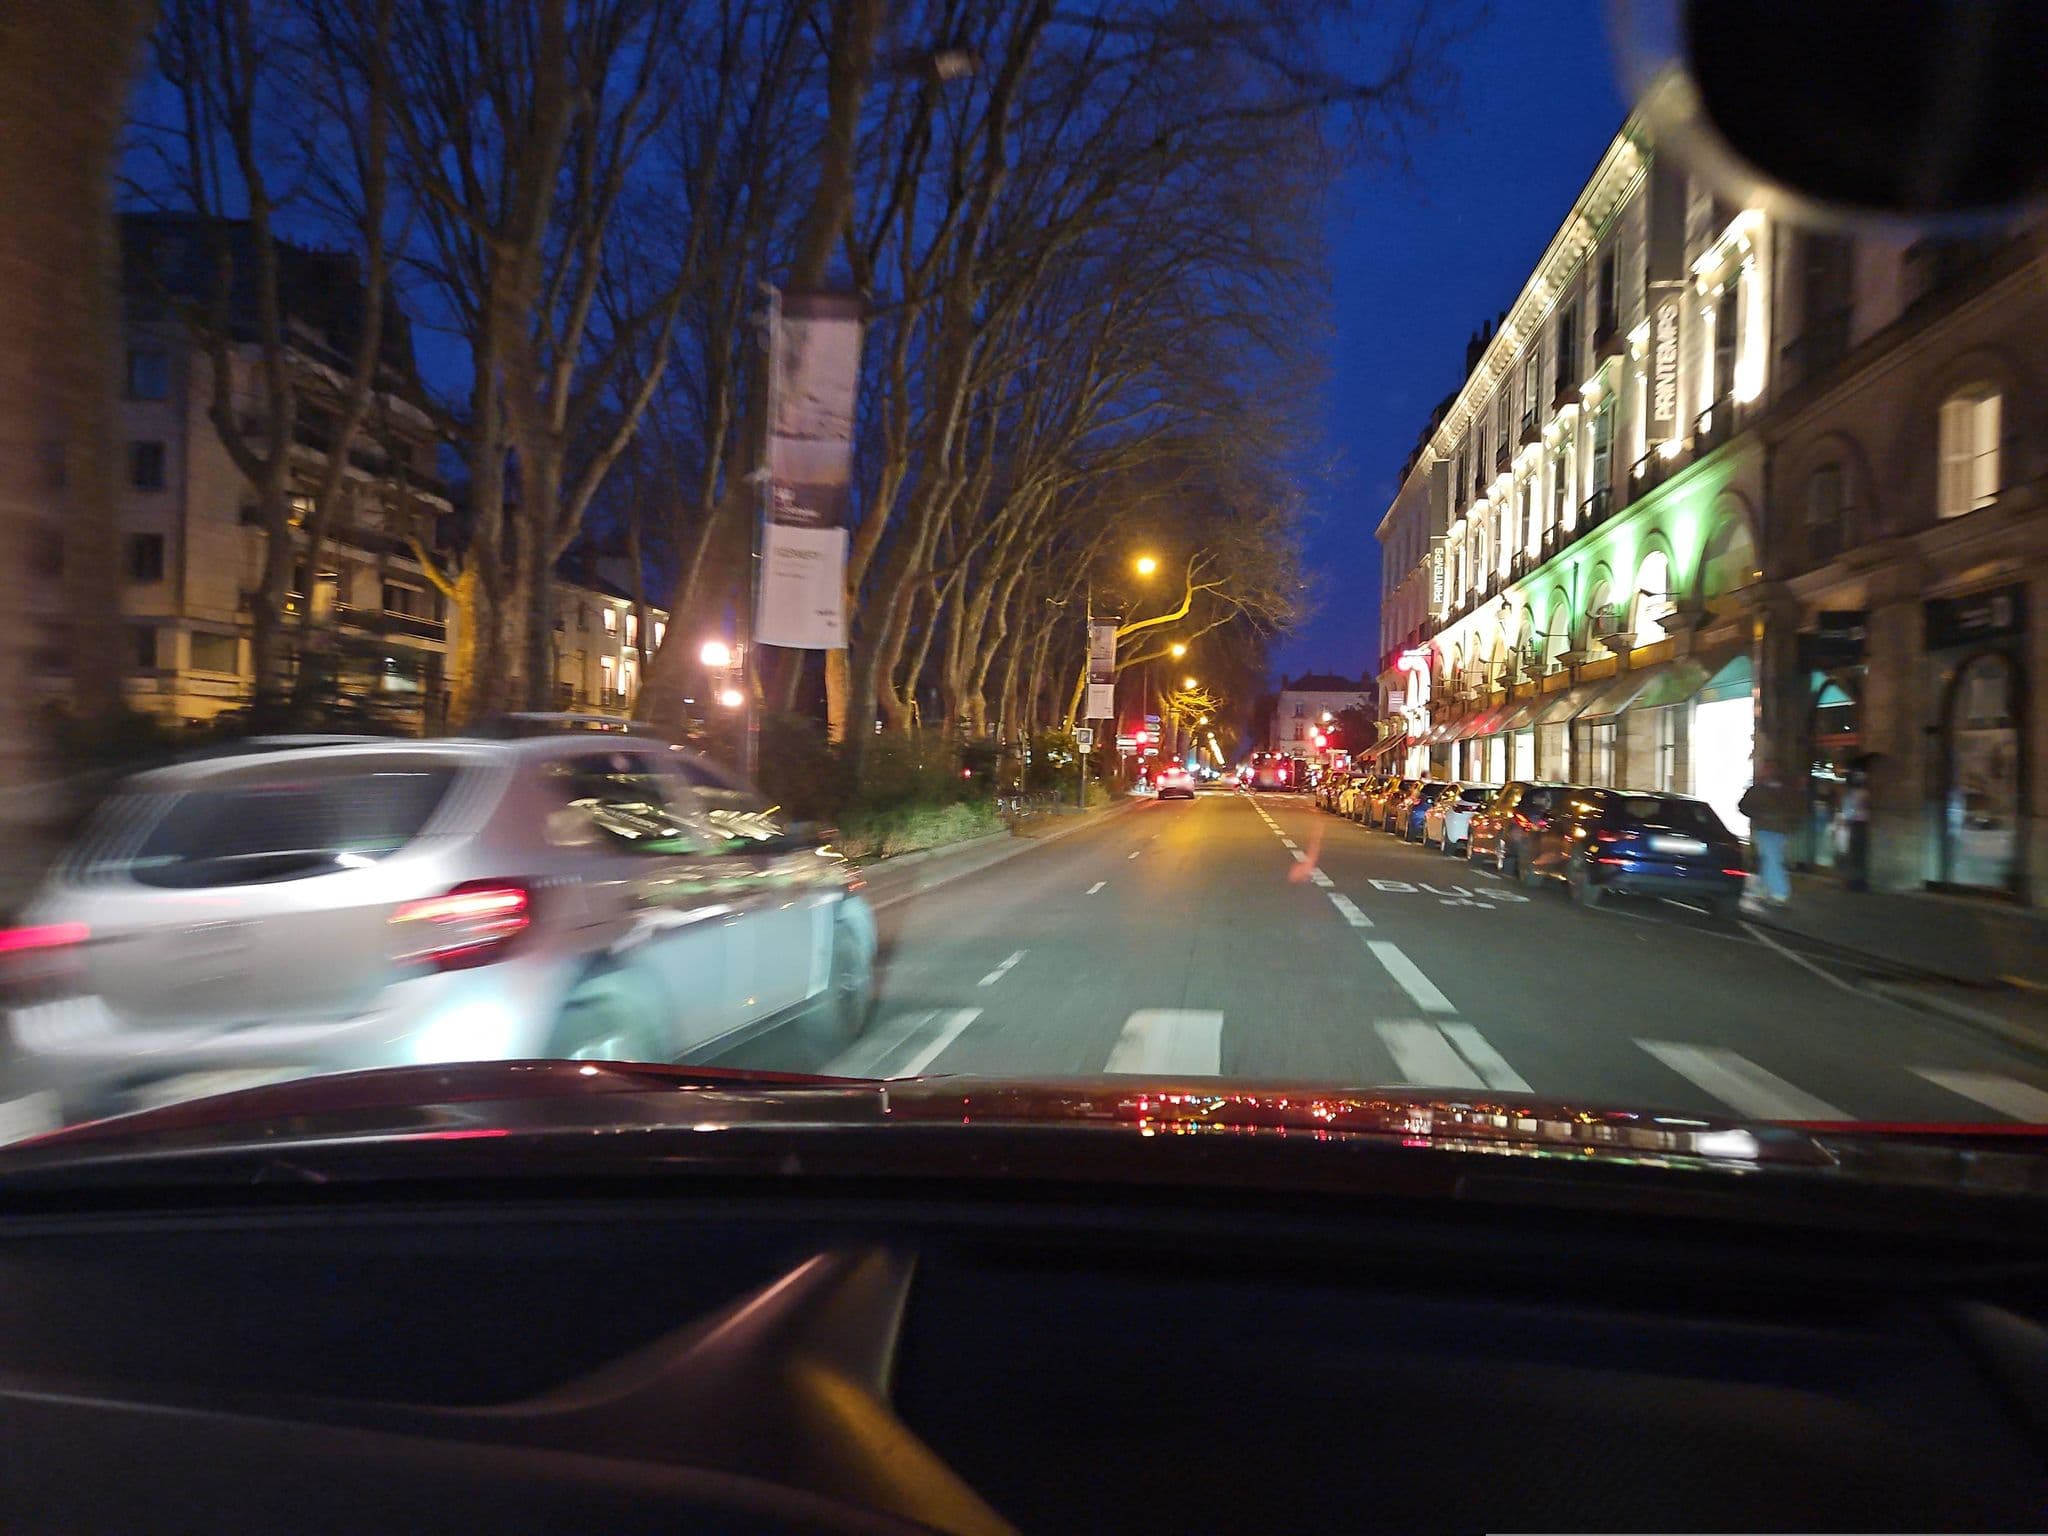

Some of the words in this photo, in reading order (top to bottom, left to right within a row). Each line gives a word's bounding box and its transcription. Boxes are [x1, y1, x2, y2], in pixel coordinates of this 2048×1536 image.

[1653, 302, 1680, 422] PRINTEMPS
[1433, 546, 1445, 604] PRINTEMPS
[1367, 878, 1531, 902] BUS
